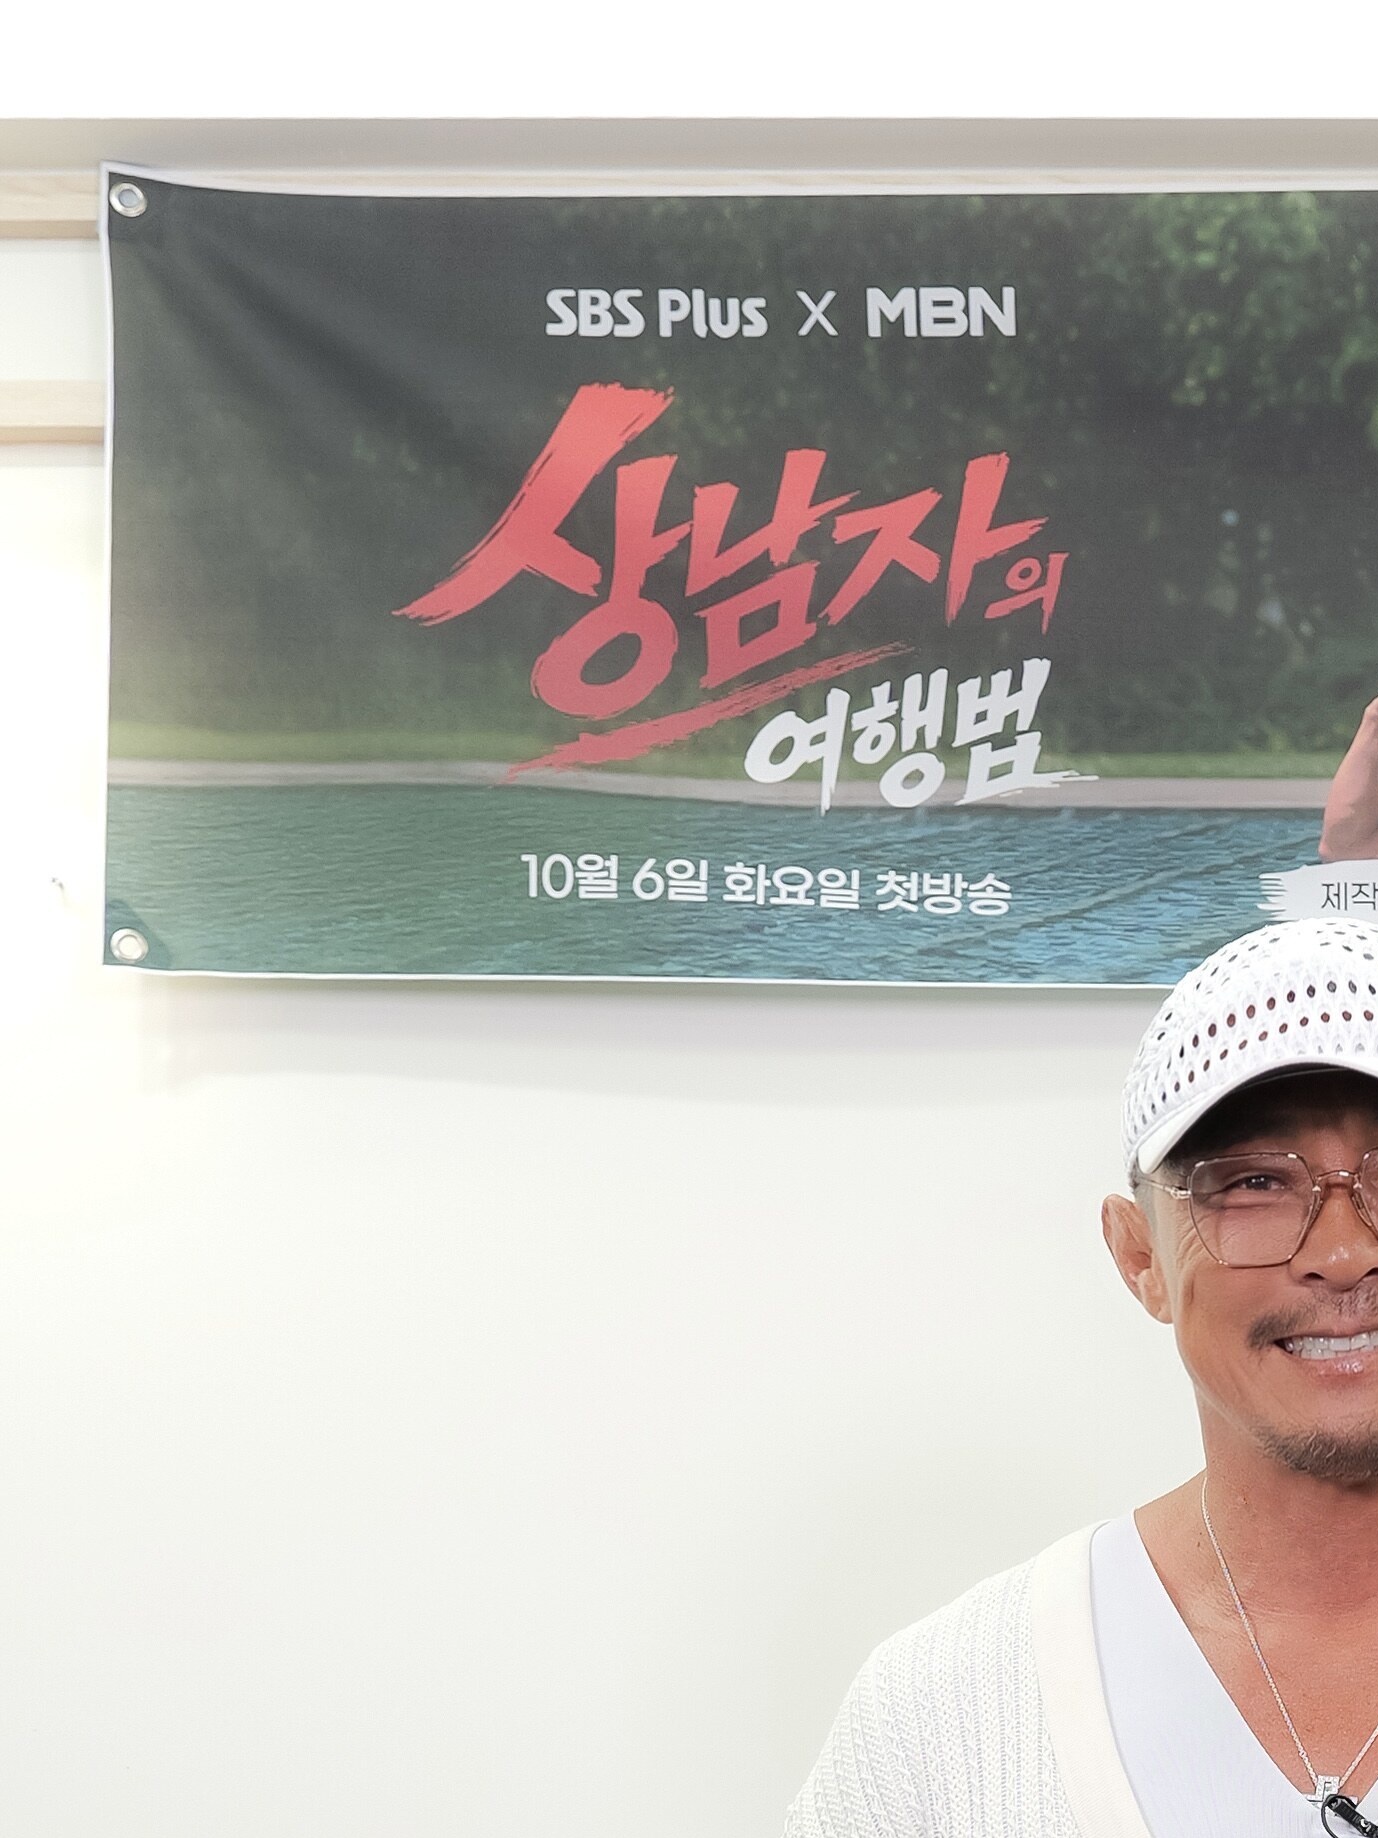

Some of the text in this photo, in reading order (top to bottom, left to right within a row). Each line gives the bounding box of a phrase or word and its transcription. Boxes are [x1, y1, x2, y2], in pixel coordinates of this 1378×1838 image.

[545, 288, 645, 337] SBS
[658, 287, 768, 339] Plus
[866, 286, 1017, 338] MBN
[392, 381, 1069, 720] 상남자의
[743, 657, 1099, 816] 여행법
[519, 852, 1014, 915] 10월 6일 화요일 첫방송
